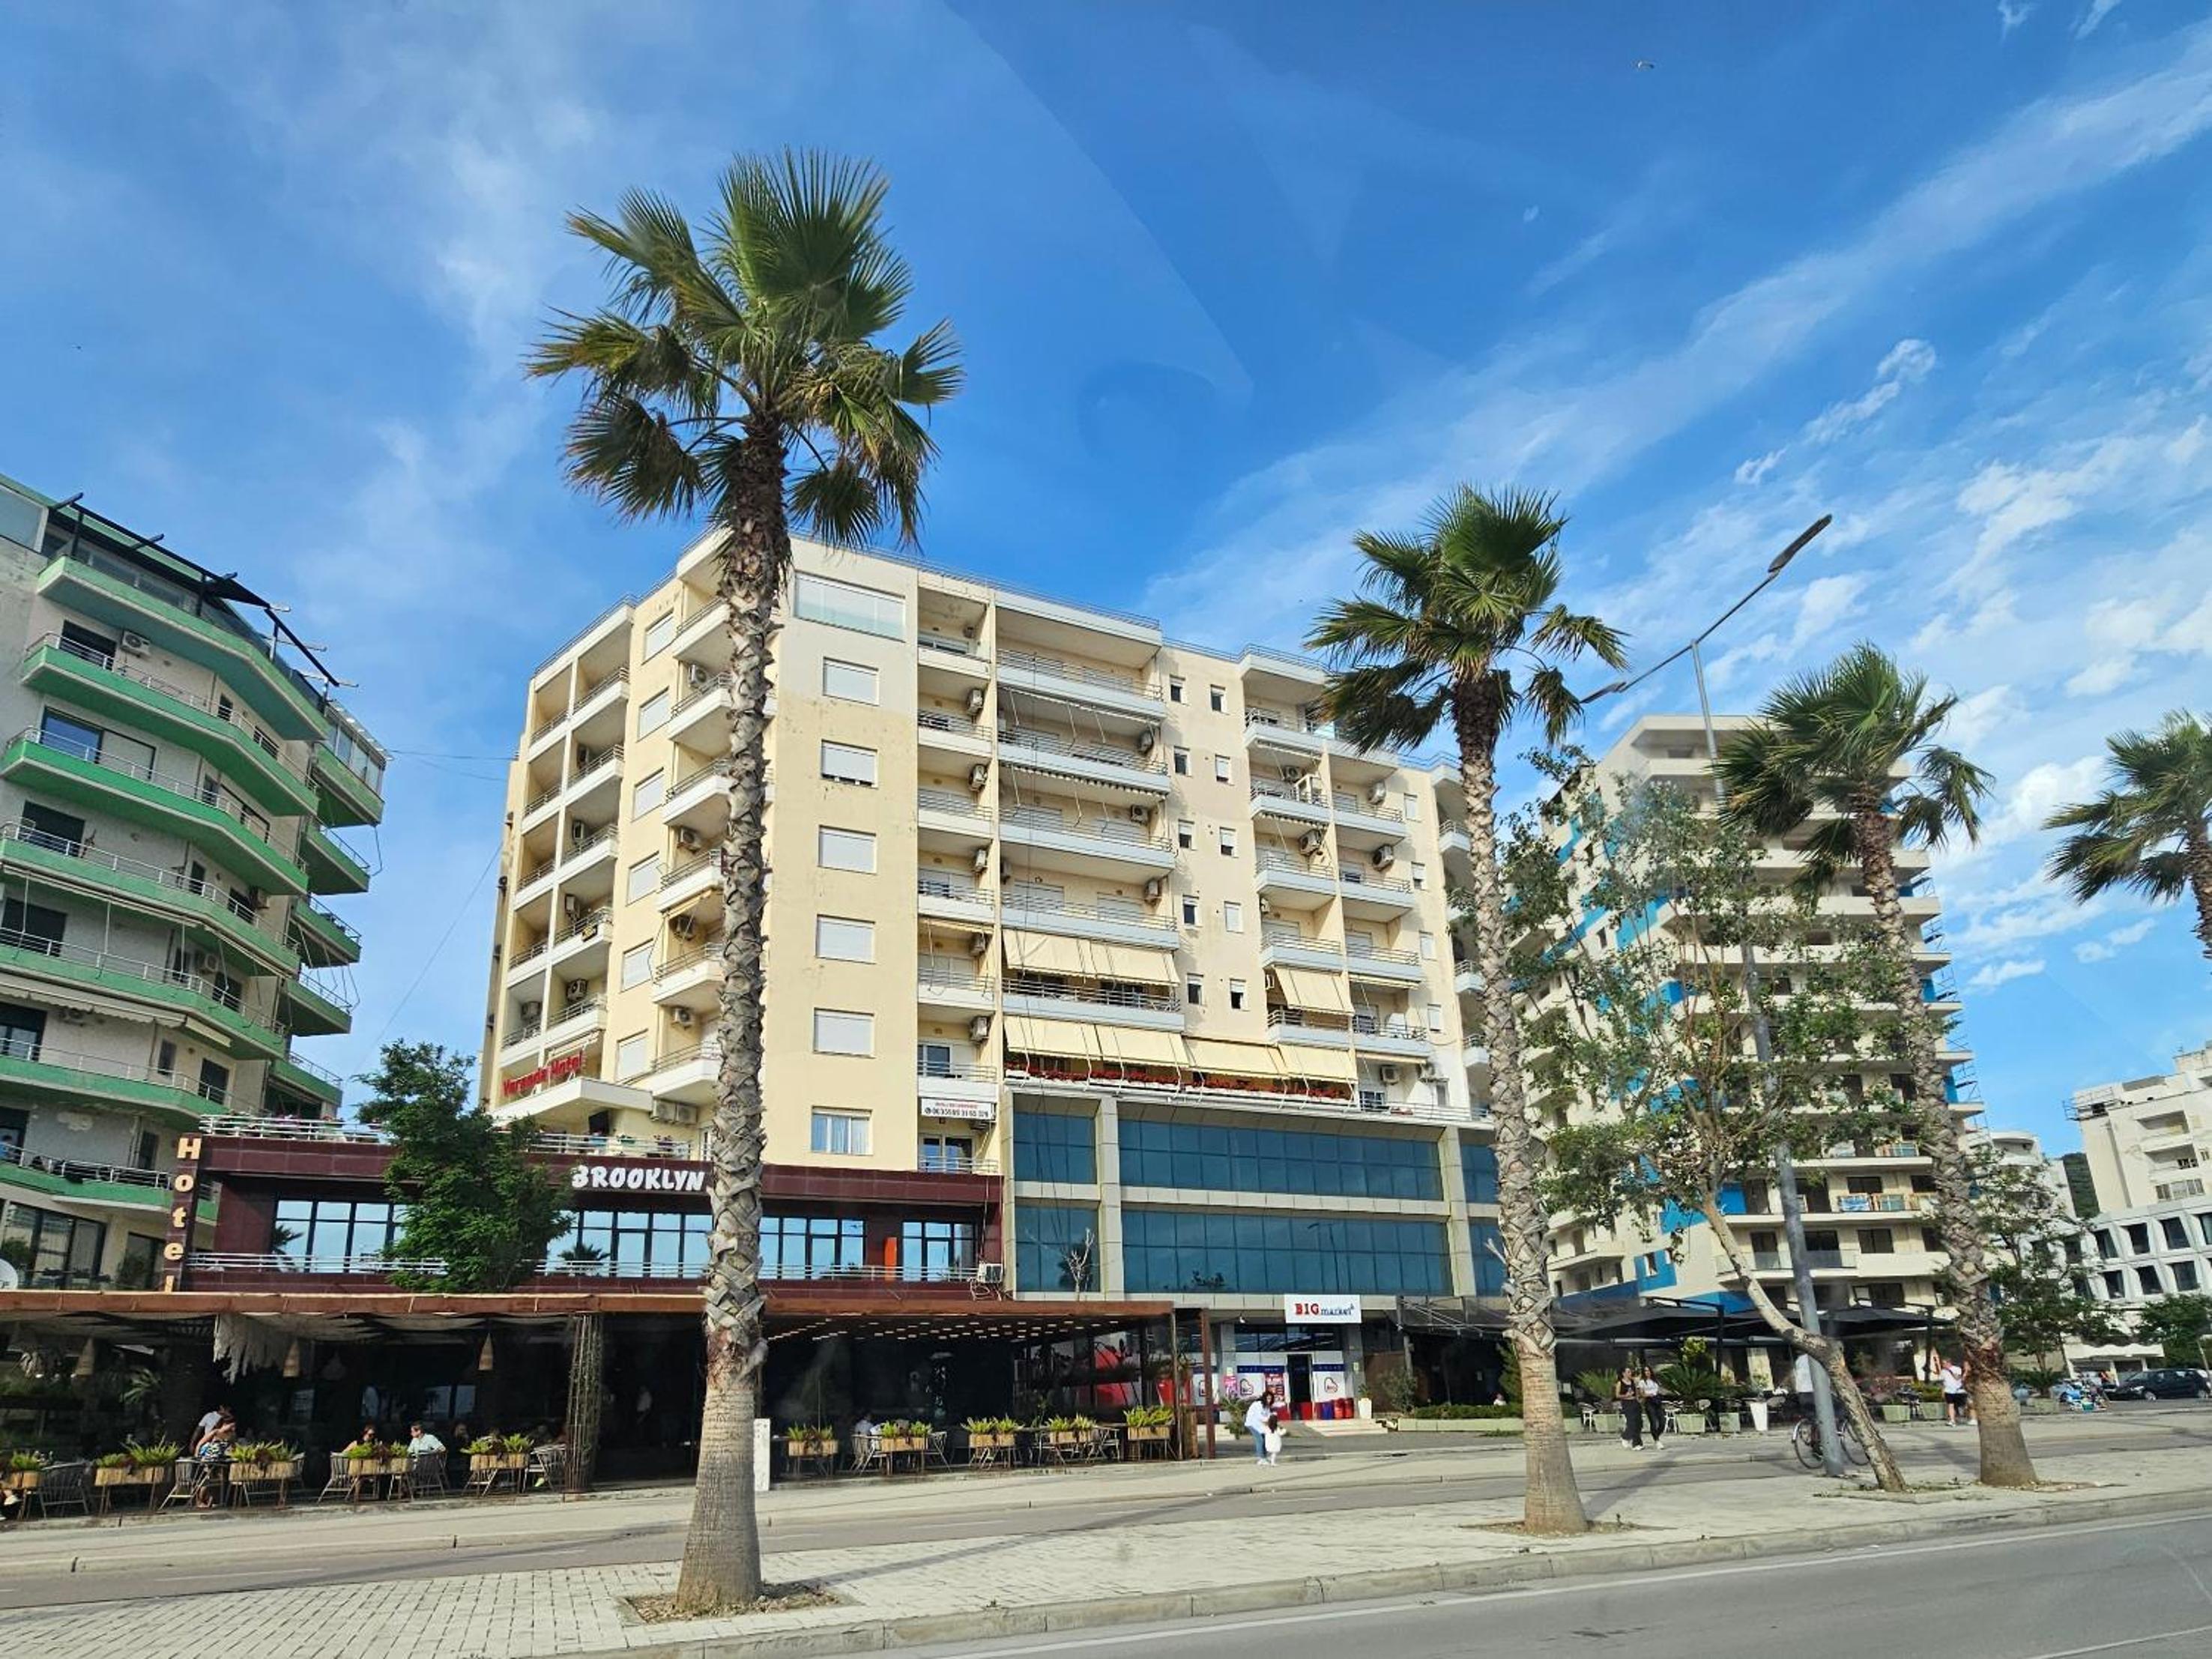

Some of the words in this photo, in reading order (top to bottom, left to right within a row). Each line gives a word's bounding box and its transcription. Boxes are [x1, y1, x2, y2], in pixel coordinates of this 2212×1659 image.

[571, 1164, 705, 1191] BROOKLYN
[163, 1137, 202, 1294] Hotel
[1295, 1303, 1319, 1315] BIG
